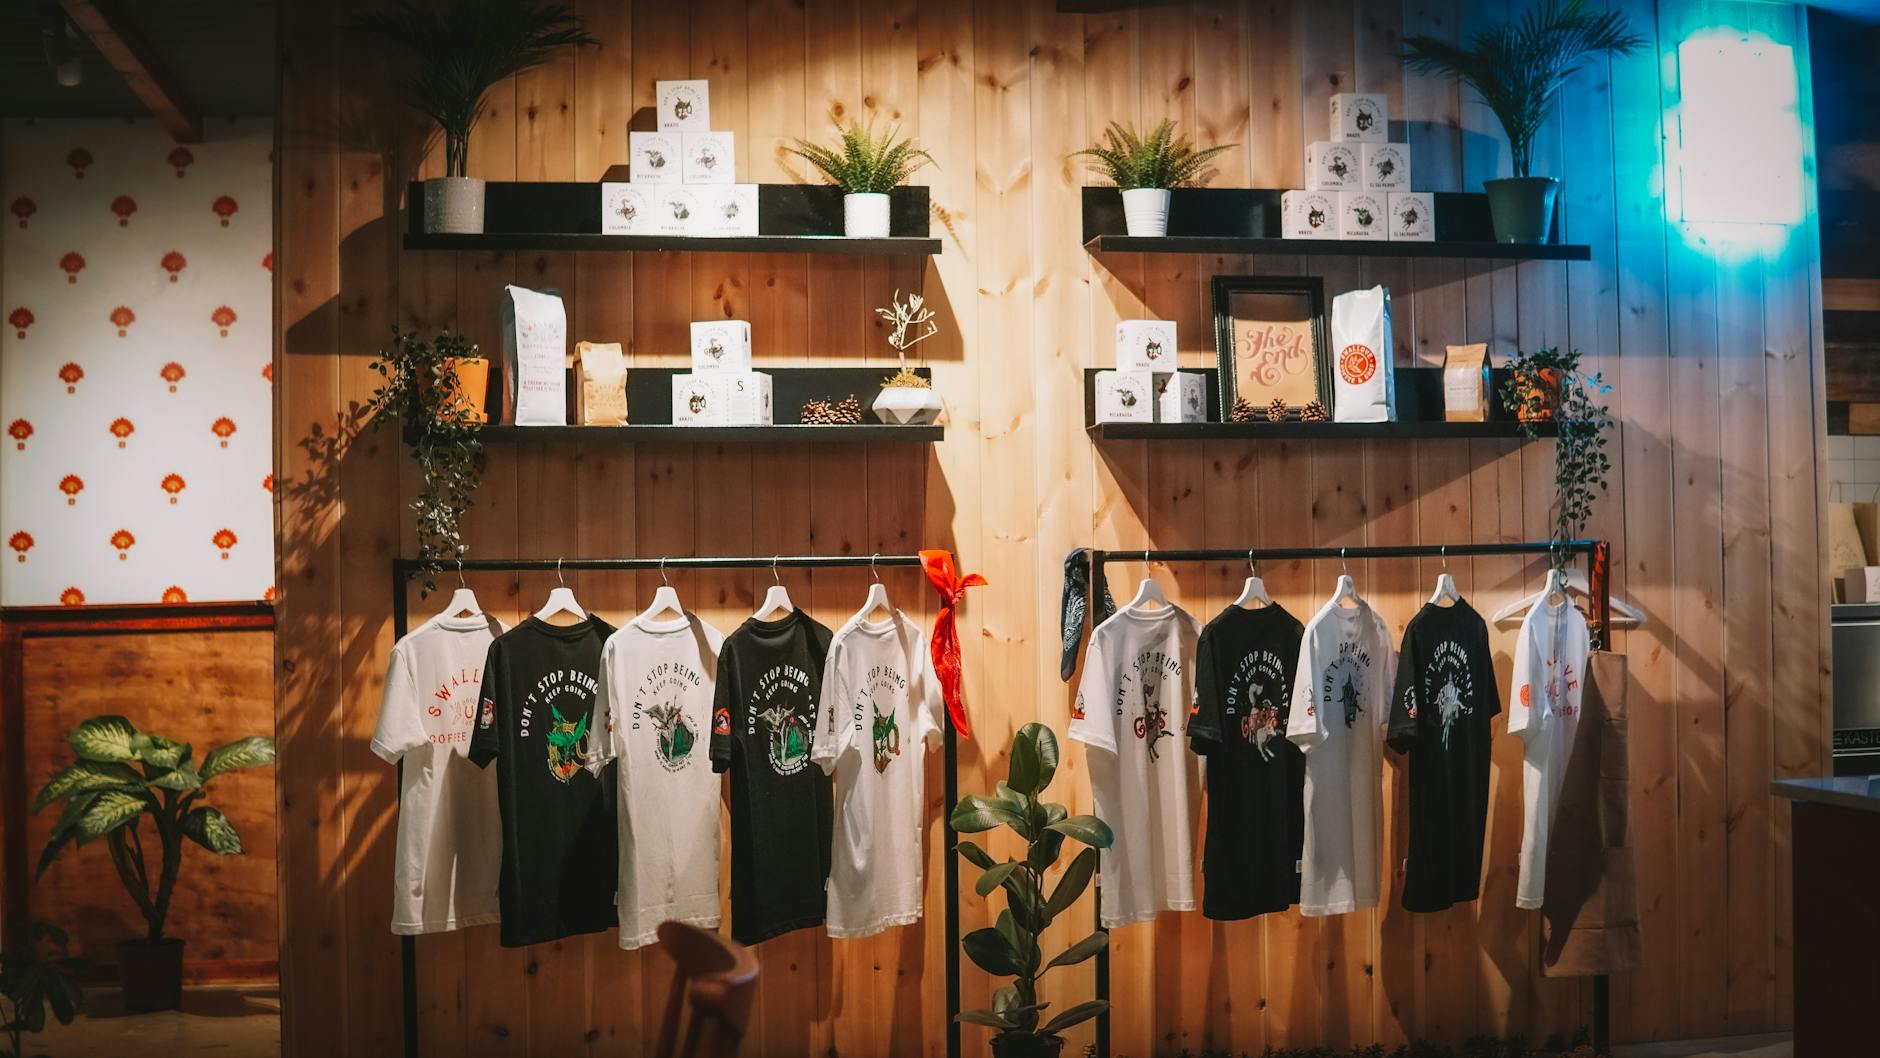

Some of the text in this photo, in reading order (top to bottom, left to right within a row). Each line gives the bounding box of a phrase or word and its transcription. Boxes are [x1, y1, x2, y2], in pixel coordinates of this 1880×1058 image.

[1236, 326, 1293, 359] The
[1250, 334, 1308, 387] End
[738, 380, 744, 391] S
[1433, 641, 1448, 662] STOP
[1450, 641, 1467, 664] BEING
[652, 677, 688, 696] KEEP GOING
[765, 680, 798, 700] KEEP GOING
[1116, 652, 1182, 716] DON'T STOP BEING
[1226, 672, 1241, 714] DON'T
[1240, 650, 1259, 672] STOP
[1259, 665, 1276, 680] GOING
[1323, 660, 1339, 702] DON'T
[520, 669, 599, 737] DON'T STOP BEING
[544, 685, 587, 704] KEEP GOING
[632, 662, 700, 730] DON'T STOP BEING
[748, 691, 760, 735] DON'T
[759, 666, 780, 690] STOP
[784, 664, 809, 687] BEING
[854, 688, 868, 731] DON'T
[884, 665, 905, 689] BEING
[429, 732, 467, 744] COFFEE
